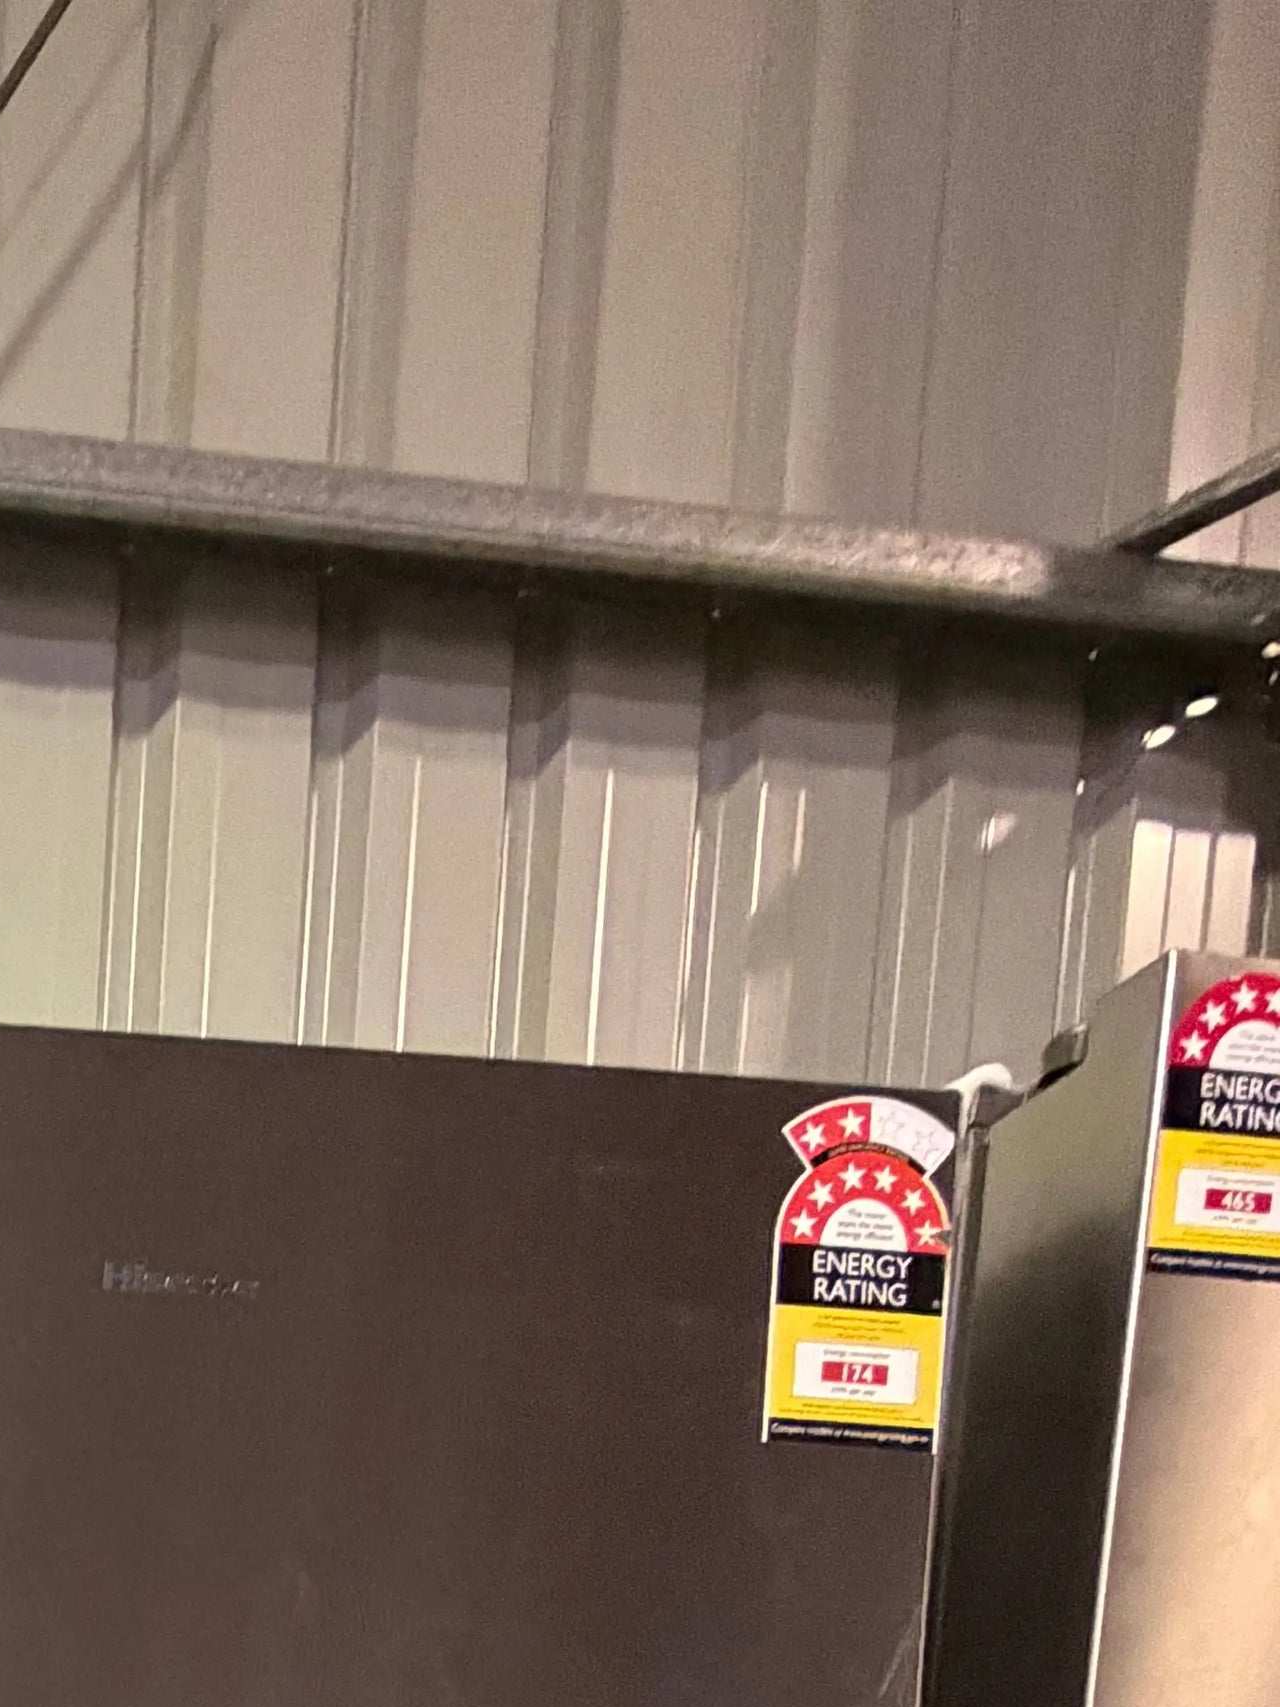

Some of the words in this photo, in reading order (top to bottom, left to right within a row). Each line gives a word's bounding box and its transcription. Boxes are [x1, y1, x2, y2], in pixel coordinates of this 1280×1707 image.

[1199, 1100, 1280, 1132] RATIN
[1221, 1191, 1256, 1212] 465
[812, 1250, 914, 1280] ENERGY
[813, 1277, 908, 1307] RATING
[841, 1363, 874, 1383] 174
